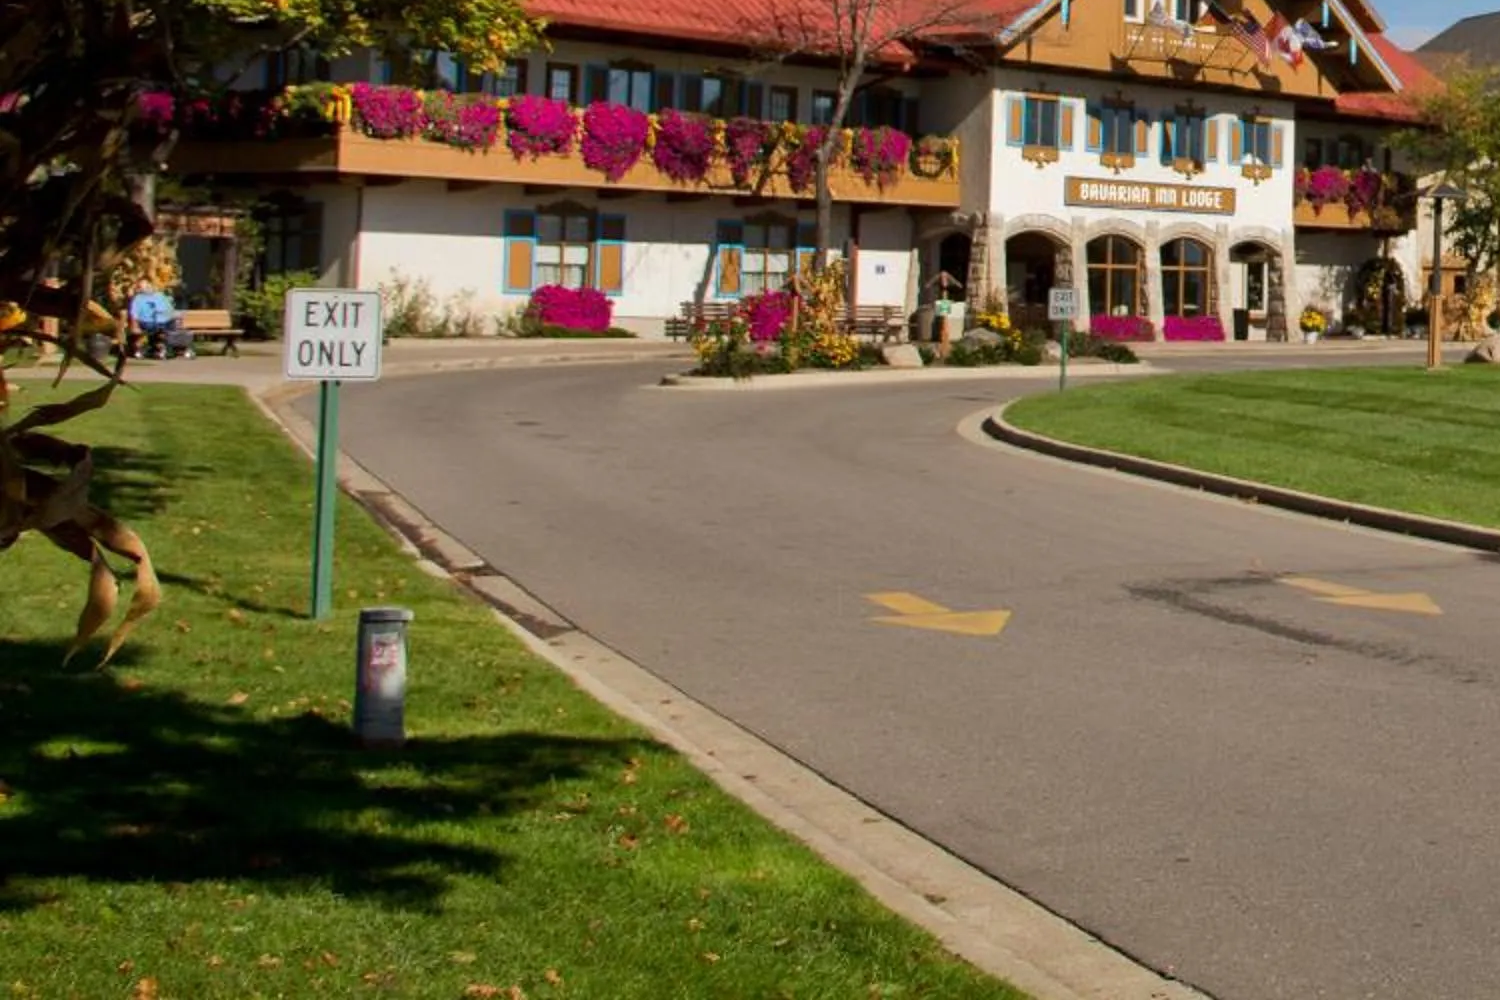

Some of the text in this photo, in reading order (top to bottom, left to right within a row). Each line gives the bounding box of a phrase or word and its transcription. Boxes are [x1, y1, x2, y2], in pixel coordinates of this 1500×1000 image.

[1080, 183, 1223, 208] BAVARIAN INN LODGE
[304, 301, 364, 328] EXIT
[298, 340, 367, 367] ONLY
